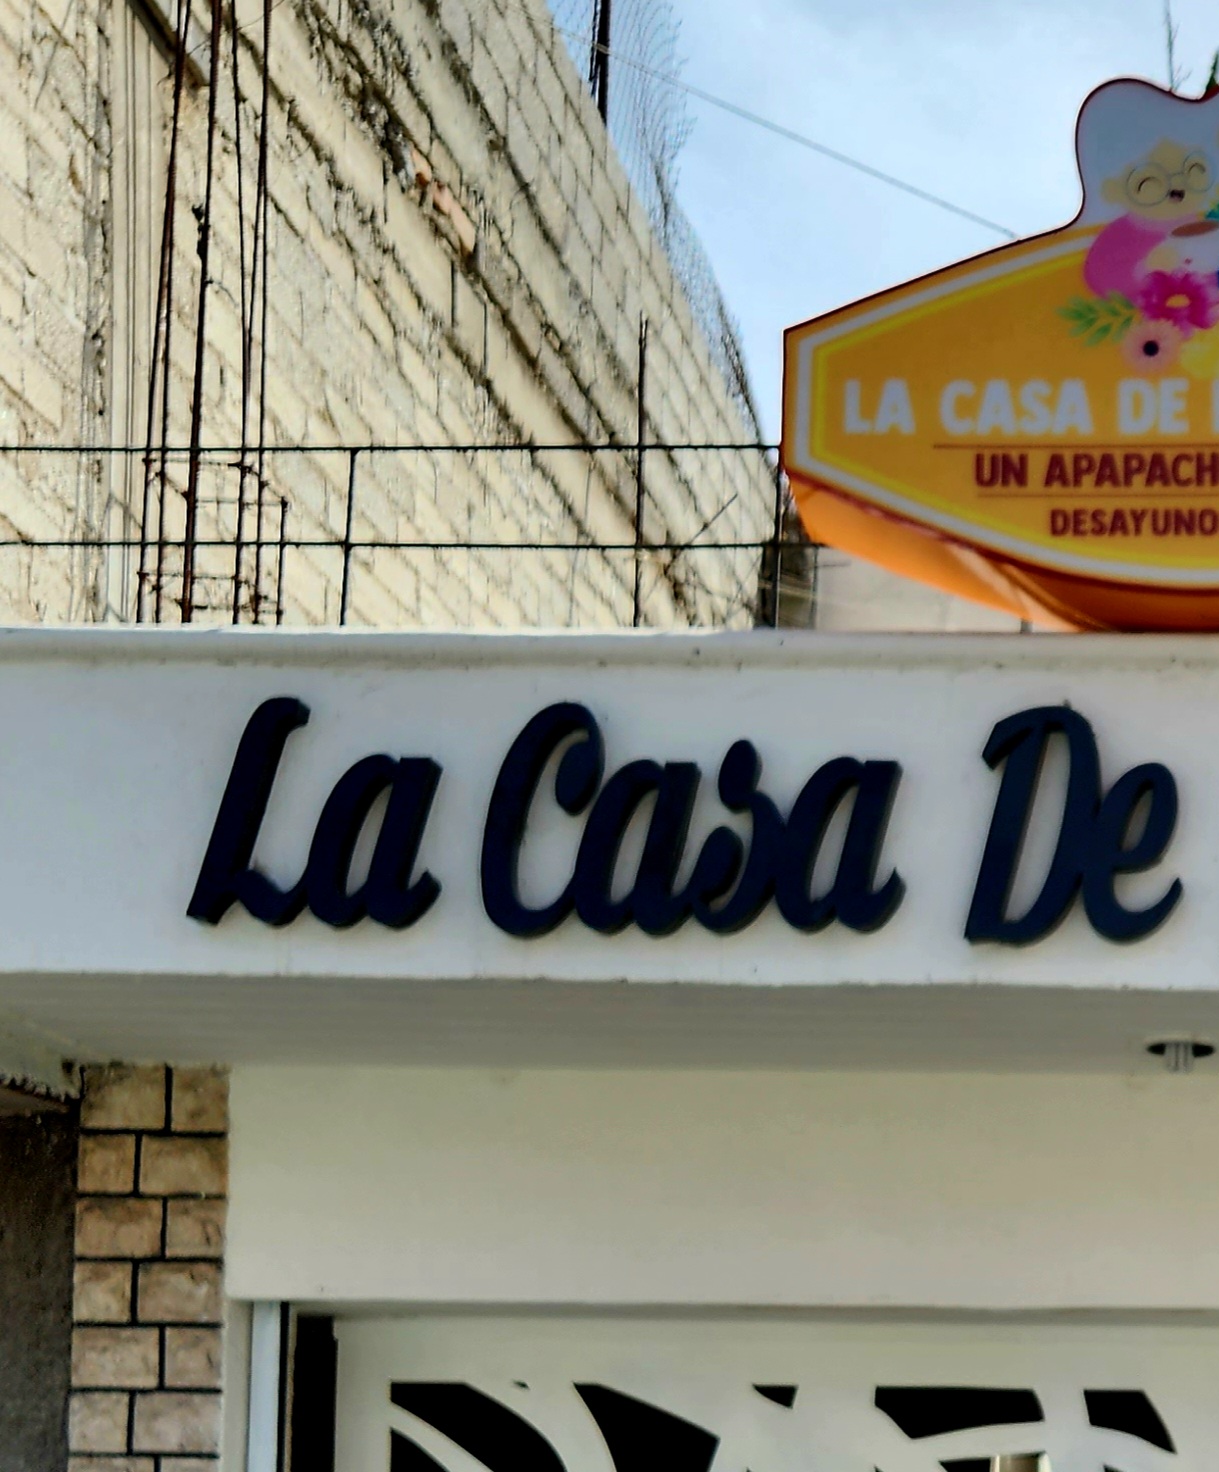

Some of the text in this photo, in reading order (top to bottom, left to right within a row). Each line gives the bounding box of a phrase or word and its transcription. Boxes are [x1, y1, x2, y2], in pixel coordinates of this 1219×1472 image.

[843, 378, 916, 435] LA
[939, 378, 1092, 436] CASA
[1117, 377, 1189, 435] DE
[975, 452, 1029, 488] UN
[186, 696, 443, 930] La
[481, 701, 906, 940] Casa
[964, 703, 1182, 948] De
